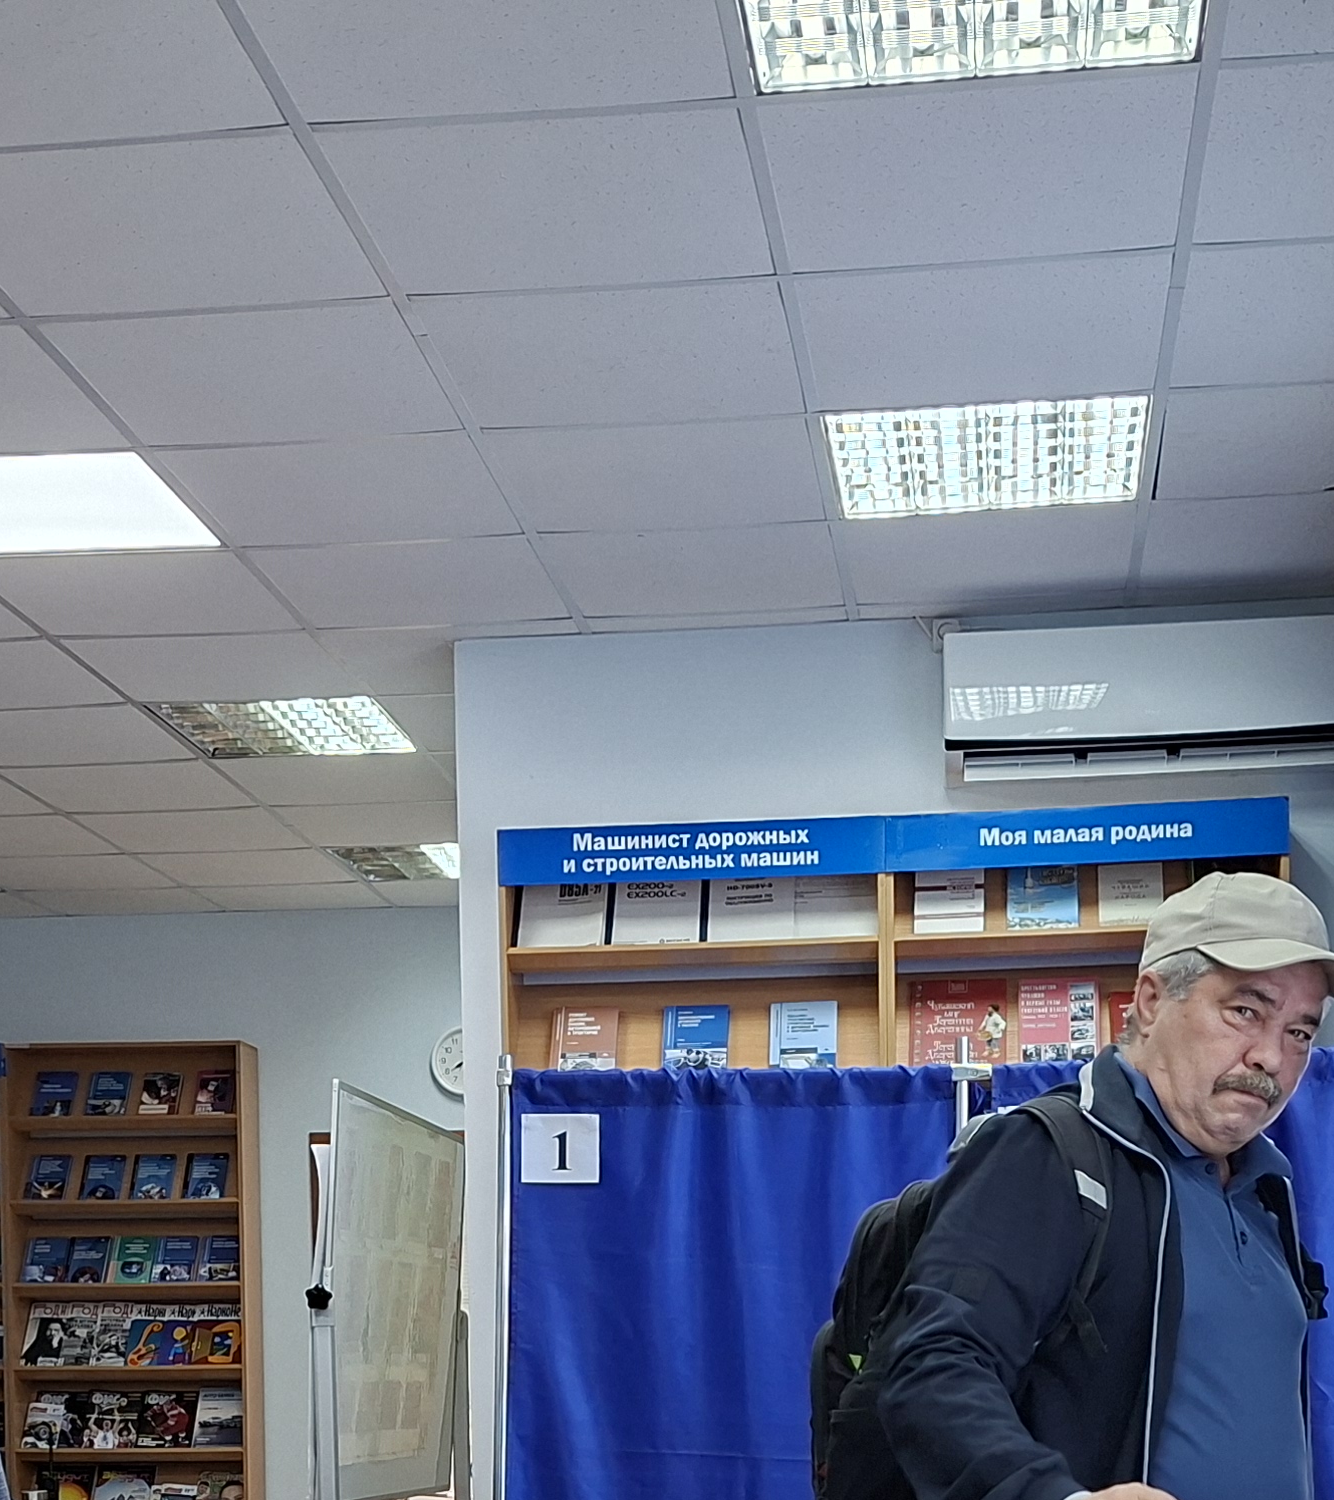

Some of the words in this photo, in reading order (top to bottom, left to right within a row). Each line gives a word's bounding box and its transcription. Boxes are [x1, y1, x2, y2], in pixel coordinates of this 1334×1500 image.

[572, 831, 690, 852] Машинист
[695, 828, 809, 850] дорожных
[979, 827, 1027, 847] Моя
[1034, 825, 1104, 845] малая
[1110, 822, 1193, 846] родина
[562, 860, 576, 873] и
[582, 852, 734, 876] строительных
[740, 847, 820, 867] машин
[444, 1046, 453, 1054] 10
[451, 1038, 459, 1046] 11
[551, 1130, 573, 1171] 1
